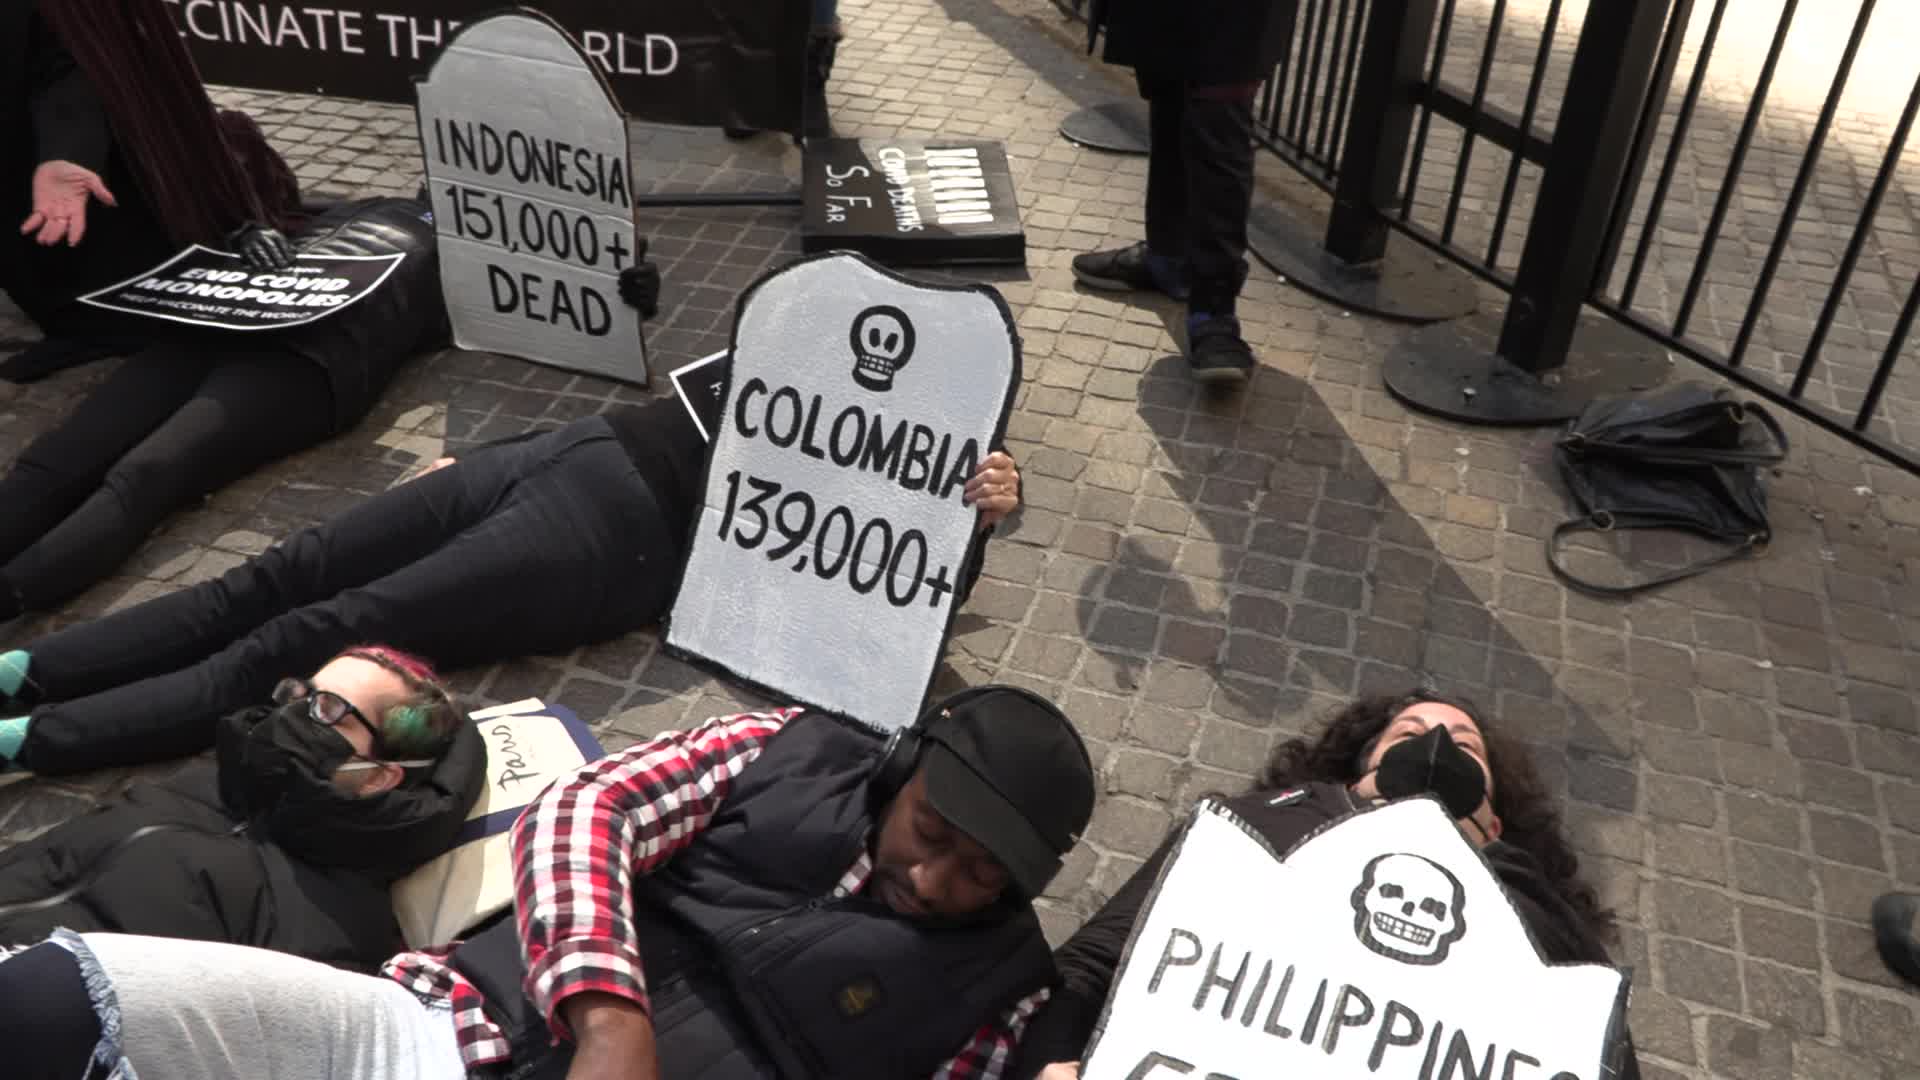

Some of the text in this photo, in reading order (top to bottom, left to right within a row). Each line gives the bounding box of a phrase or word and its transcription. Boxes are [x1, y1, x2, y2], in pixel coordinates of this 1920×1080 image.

[163, 0, 679, 75] CINATE TH RLD
[435, 118, 628, 208] INDONESIA
[446, 185, 629, 270] 151,000+
[888, 187, 924, 232] DEATHS
[134, 278, 350, 307] MONOPOLIES
[178, 268, 350, 291] END COVID
[232, 308, 261, 318] THE
[487, 264, 612, 336] DEAD
[735, 377, 978, 506] COLOMBIA
[717, 470, 953, 608] 139,000+
[1147, 928, 1581, 1080] PHILIPPIN
